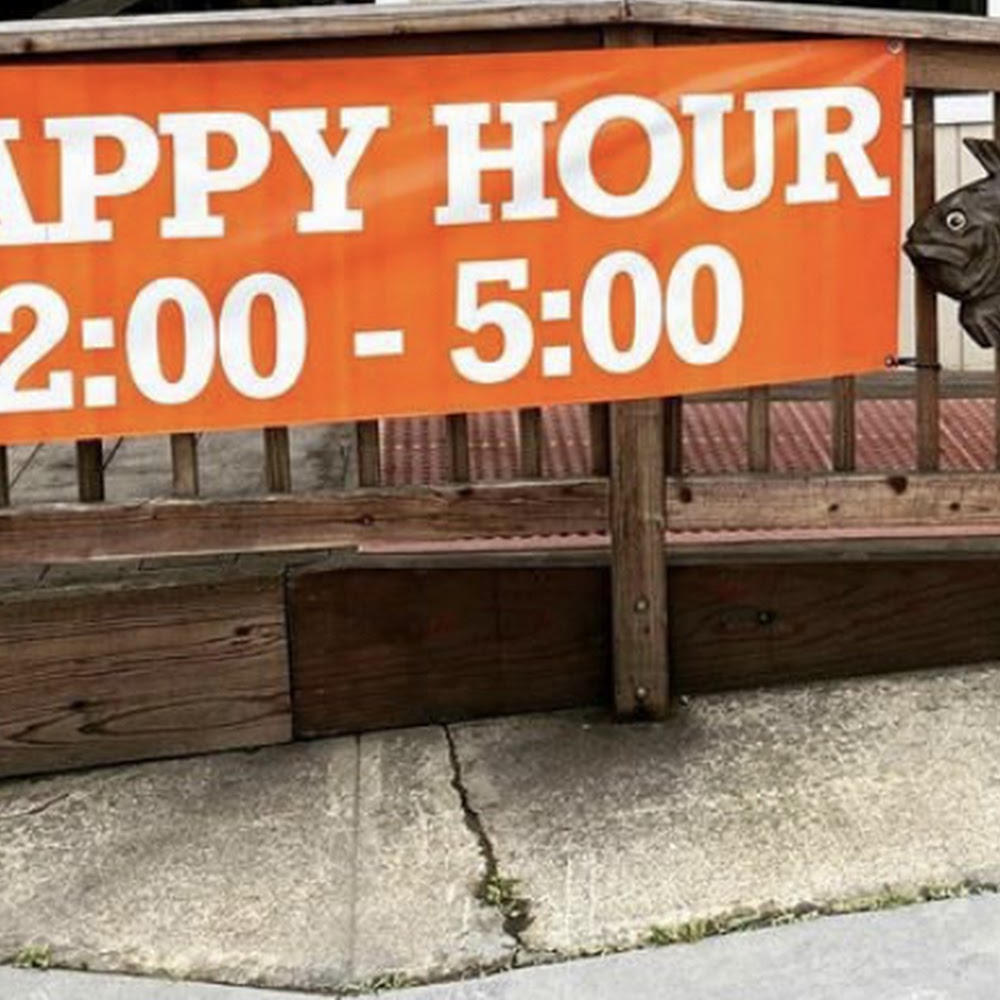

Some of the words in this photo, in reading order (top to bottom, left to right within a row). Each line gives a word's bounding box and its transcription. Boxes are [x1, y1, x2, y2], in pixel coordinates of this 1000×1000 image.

[433, 85, 893, 226] HOUR
[0, 272, 308, 414] 2:00
[353, 329, 405, 358] -
[450, 243, 744, 385] 5:00
